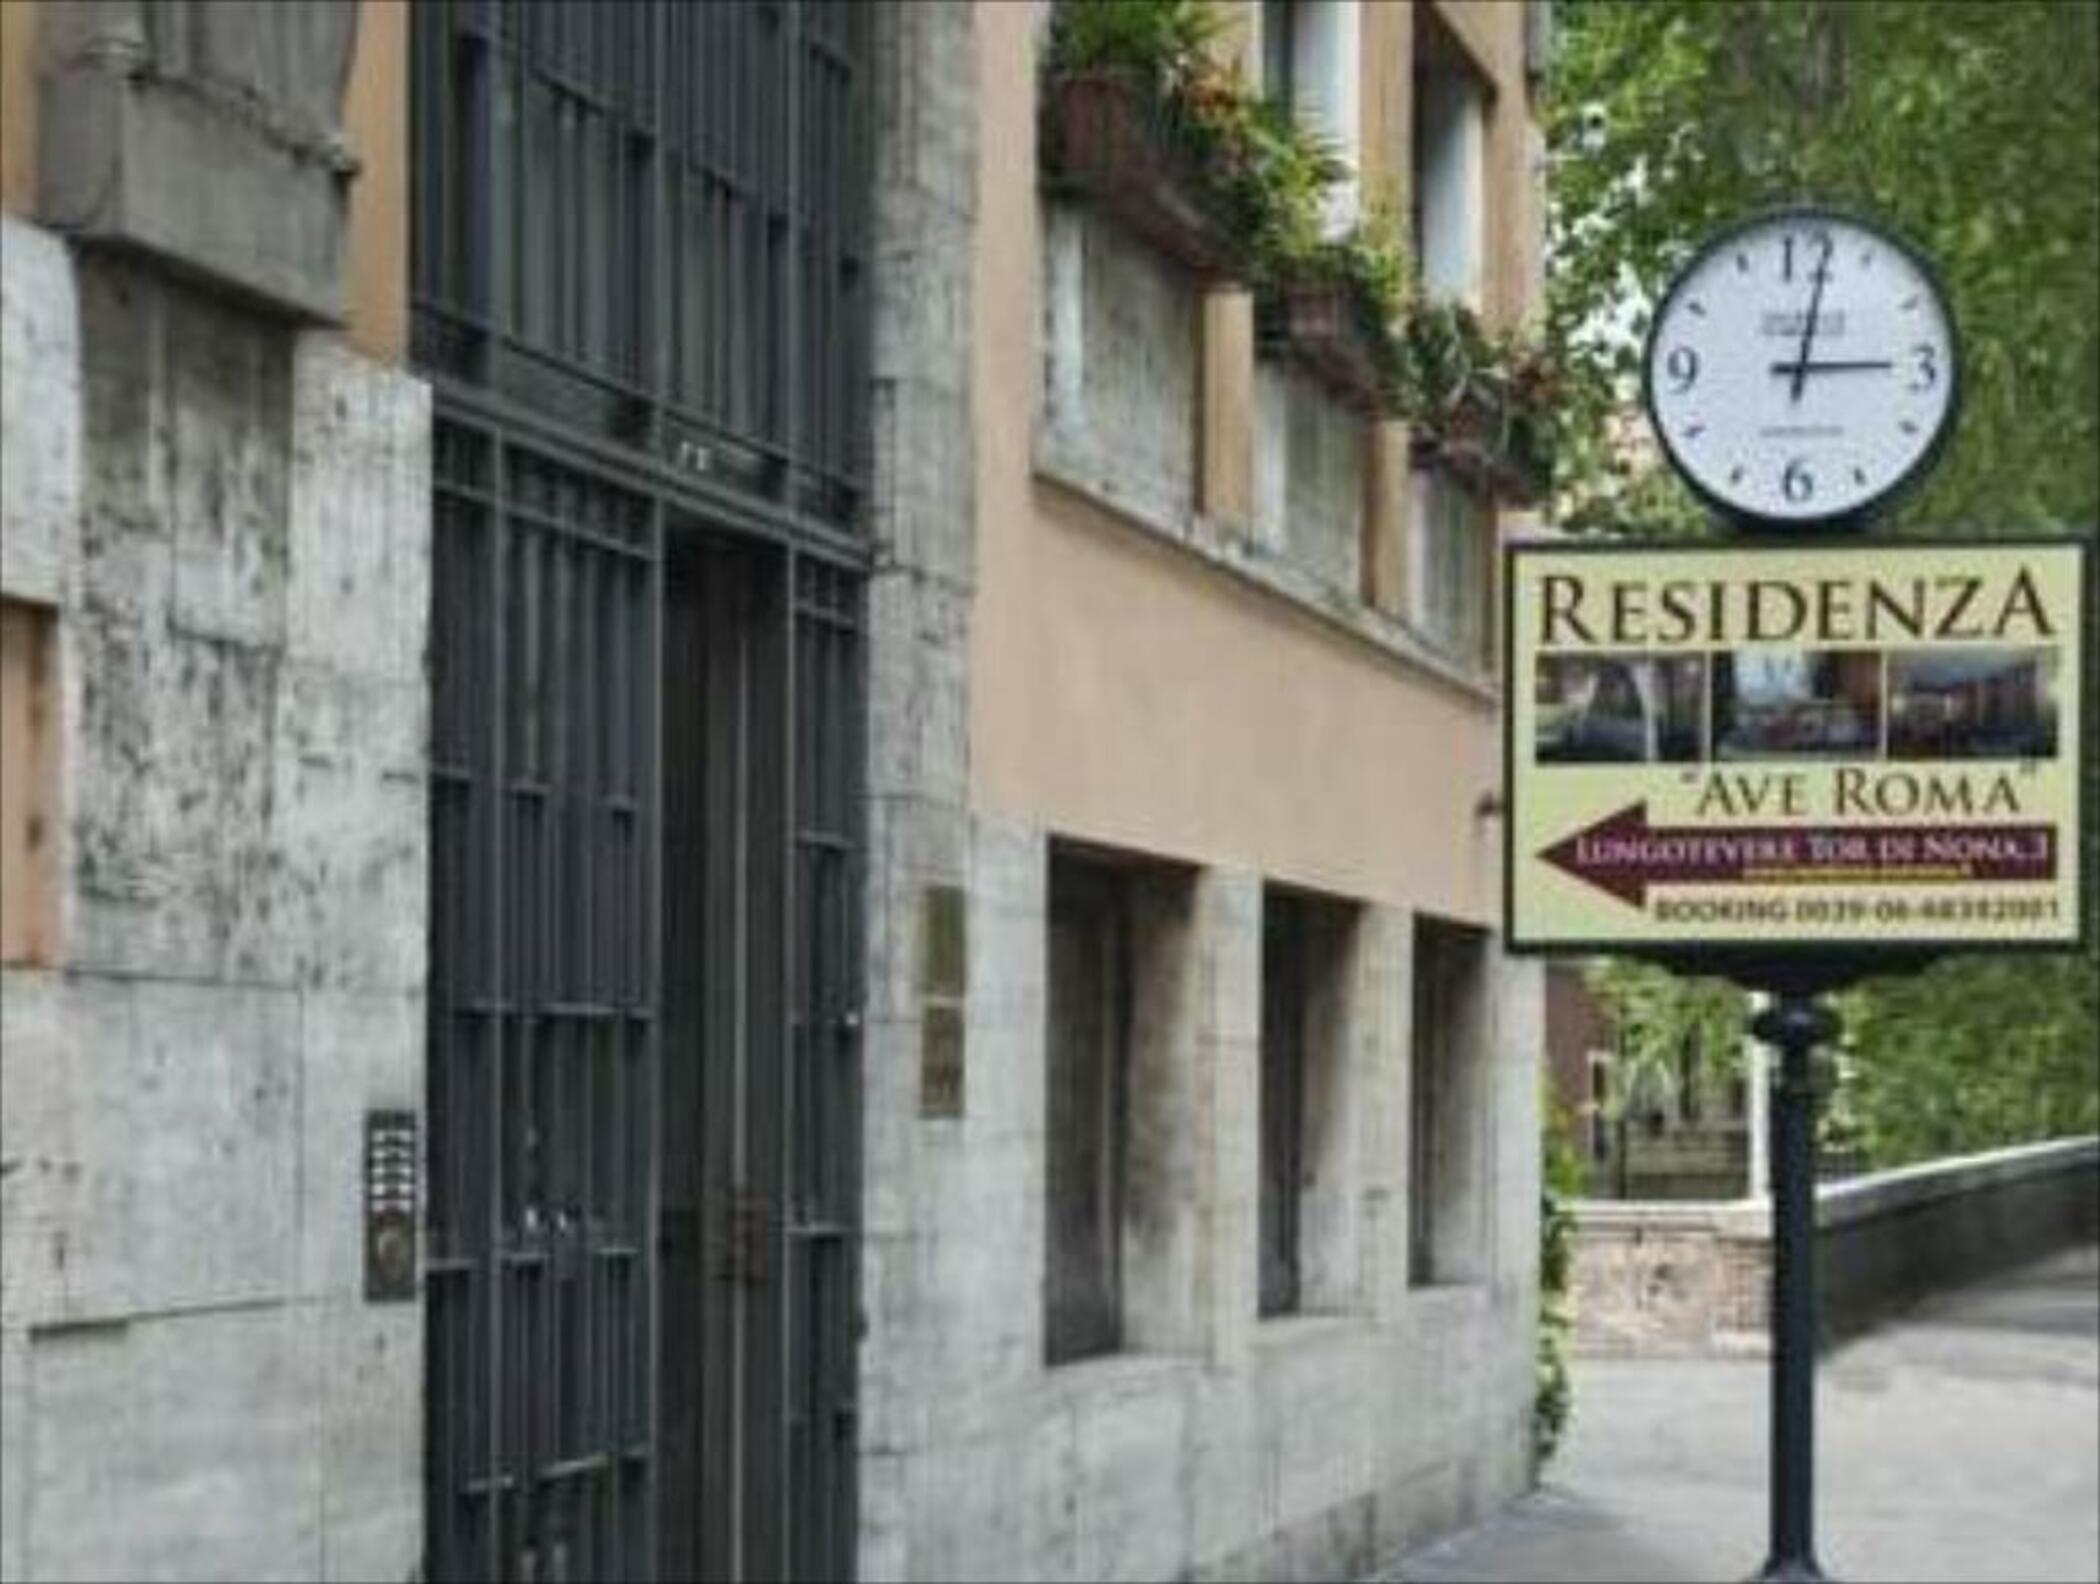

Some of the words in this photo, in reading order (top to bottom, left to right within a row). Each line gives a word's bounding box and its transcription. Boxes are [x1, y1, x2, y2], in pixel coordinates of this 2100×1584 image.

[1666, 346, 1698, 396] 9
[1911, 343, 1937, 393] 3
[1782, 457, 1814, 503] 6
[1539, 565, 2057, 643] RESIDENZA
[1655, 900, 1788, 922] BOOKING
